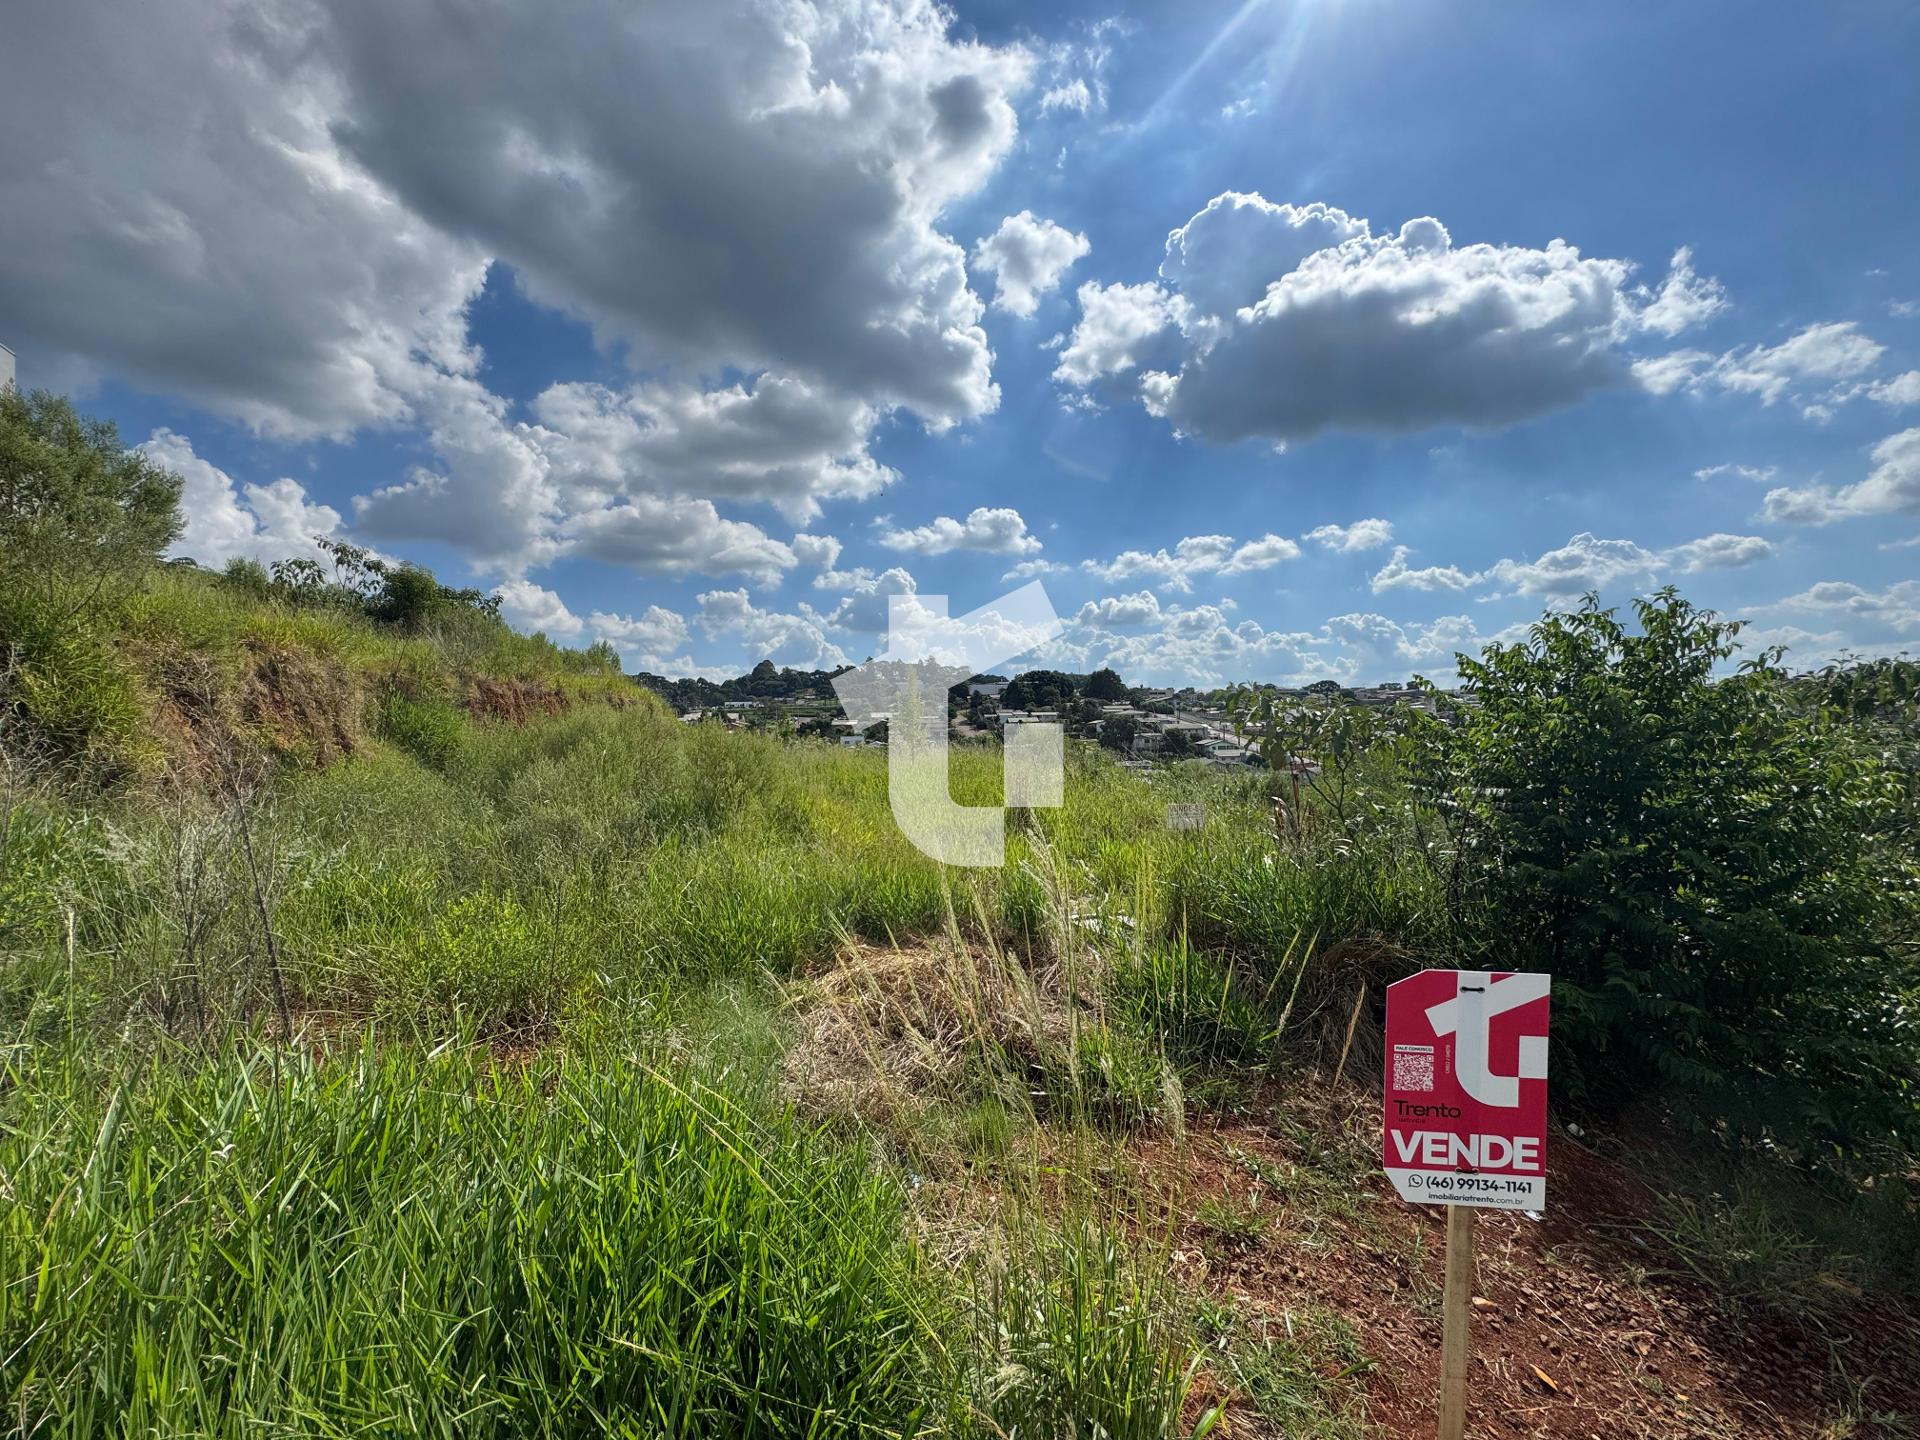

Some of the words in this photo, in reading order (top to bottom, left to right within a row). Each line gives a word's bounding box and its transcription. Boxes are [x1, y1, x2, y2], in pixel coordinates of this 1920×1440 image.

[1393, 1100, 1461, 1118] Trento
[1390, 1129, 1540, 1171] VENDE
[1426, 1176, 1454, 1190] (46)
[1457, 1178, 1532, 1194] 99134-1141
[1428, 1193, 1524, 1205] imobiliariatrento.com.br
